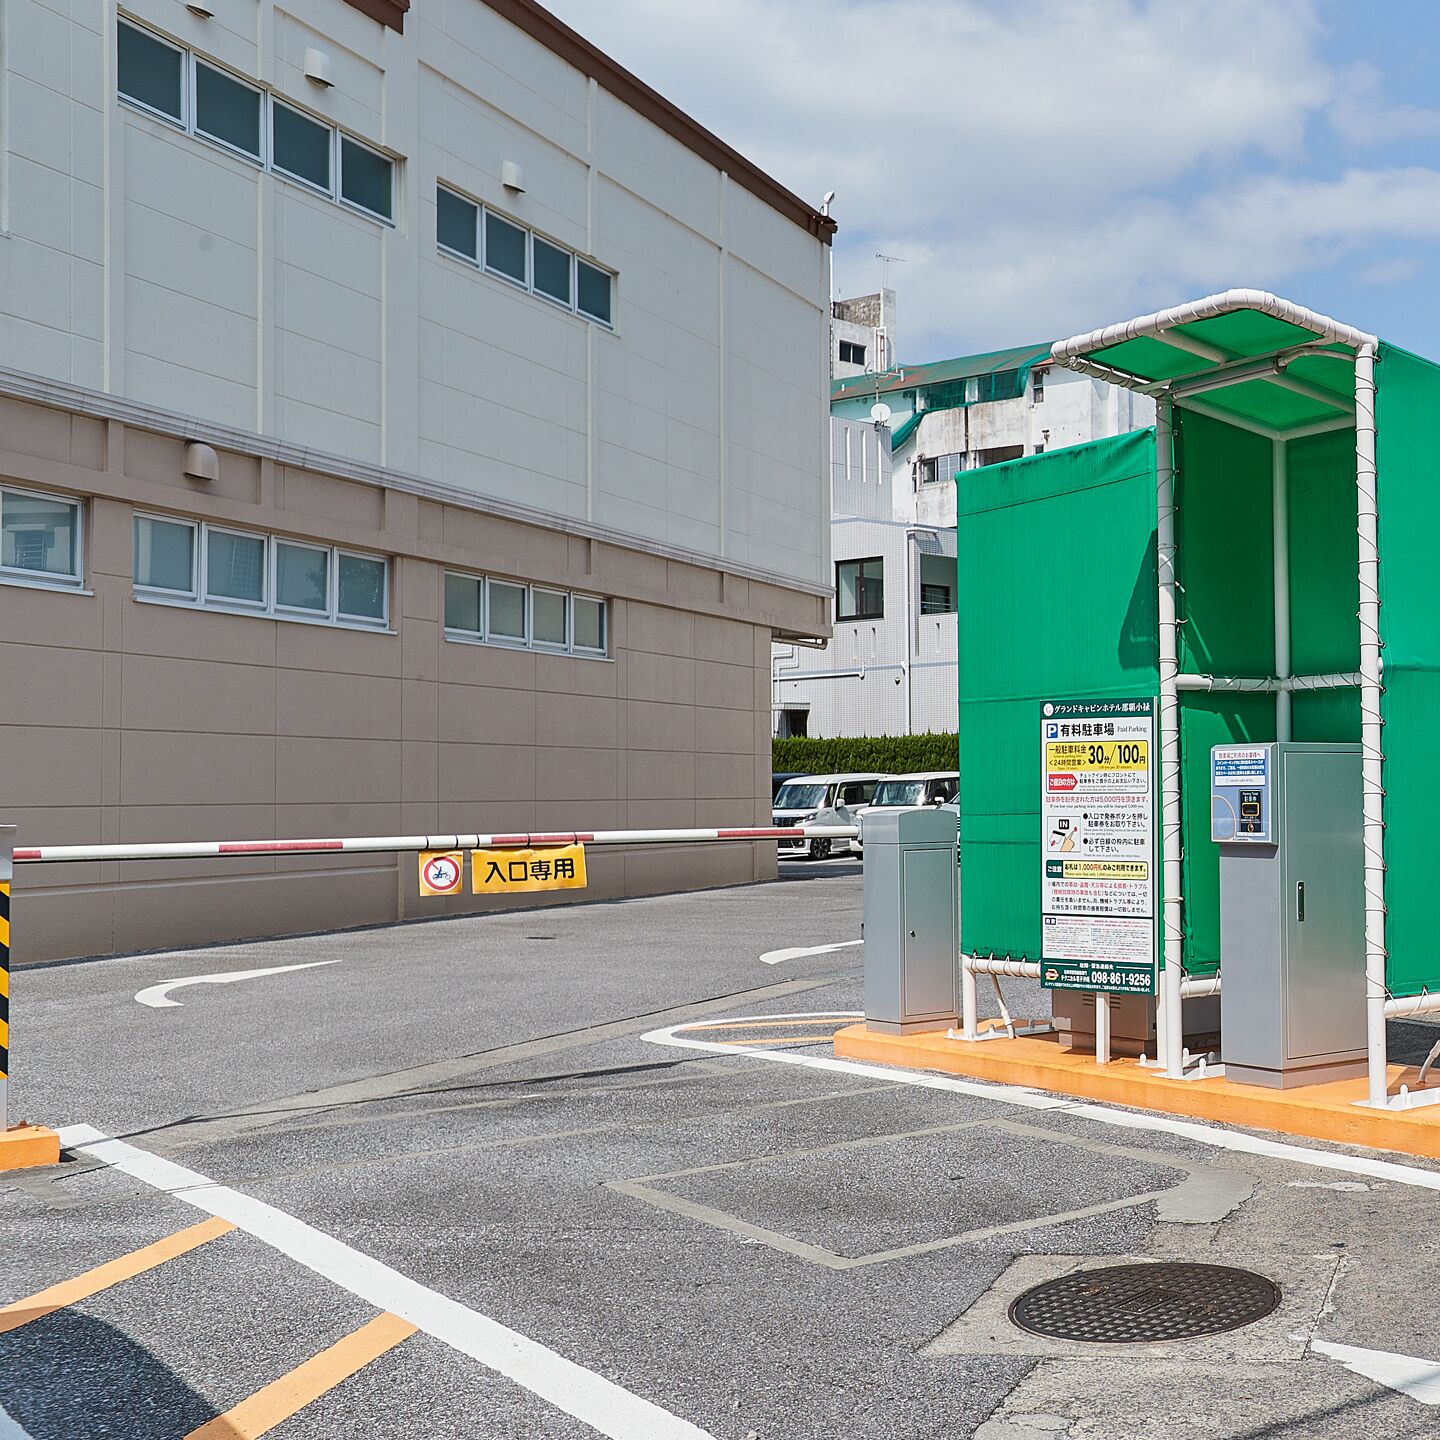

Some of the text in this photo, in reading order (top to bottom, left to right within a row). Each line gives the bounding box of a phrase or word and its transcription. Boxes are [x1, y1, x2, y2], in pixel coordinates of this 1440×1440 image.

[1054, 702, 1151, 714] グランドキャビンホテル那覇小禄
[1047, 725, 1057, 738] P
[1060, 722, 1114, 737] 有料駐車場
[1060, 820, 1069, 828] IN
[485, 858, 575, 883] 入口専用
[1091, 971, 1151, 987] 098-861-9256
